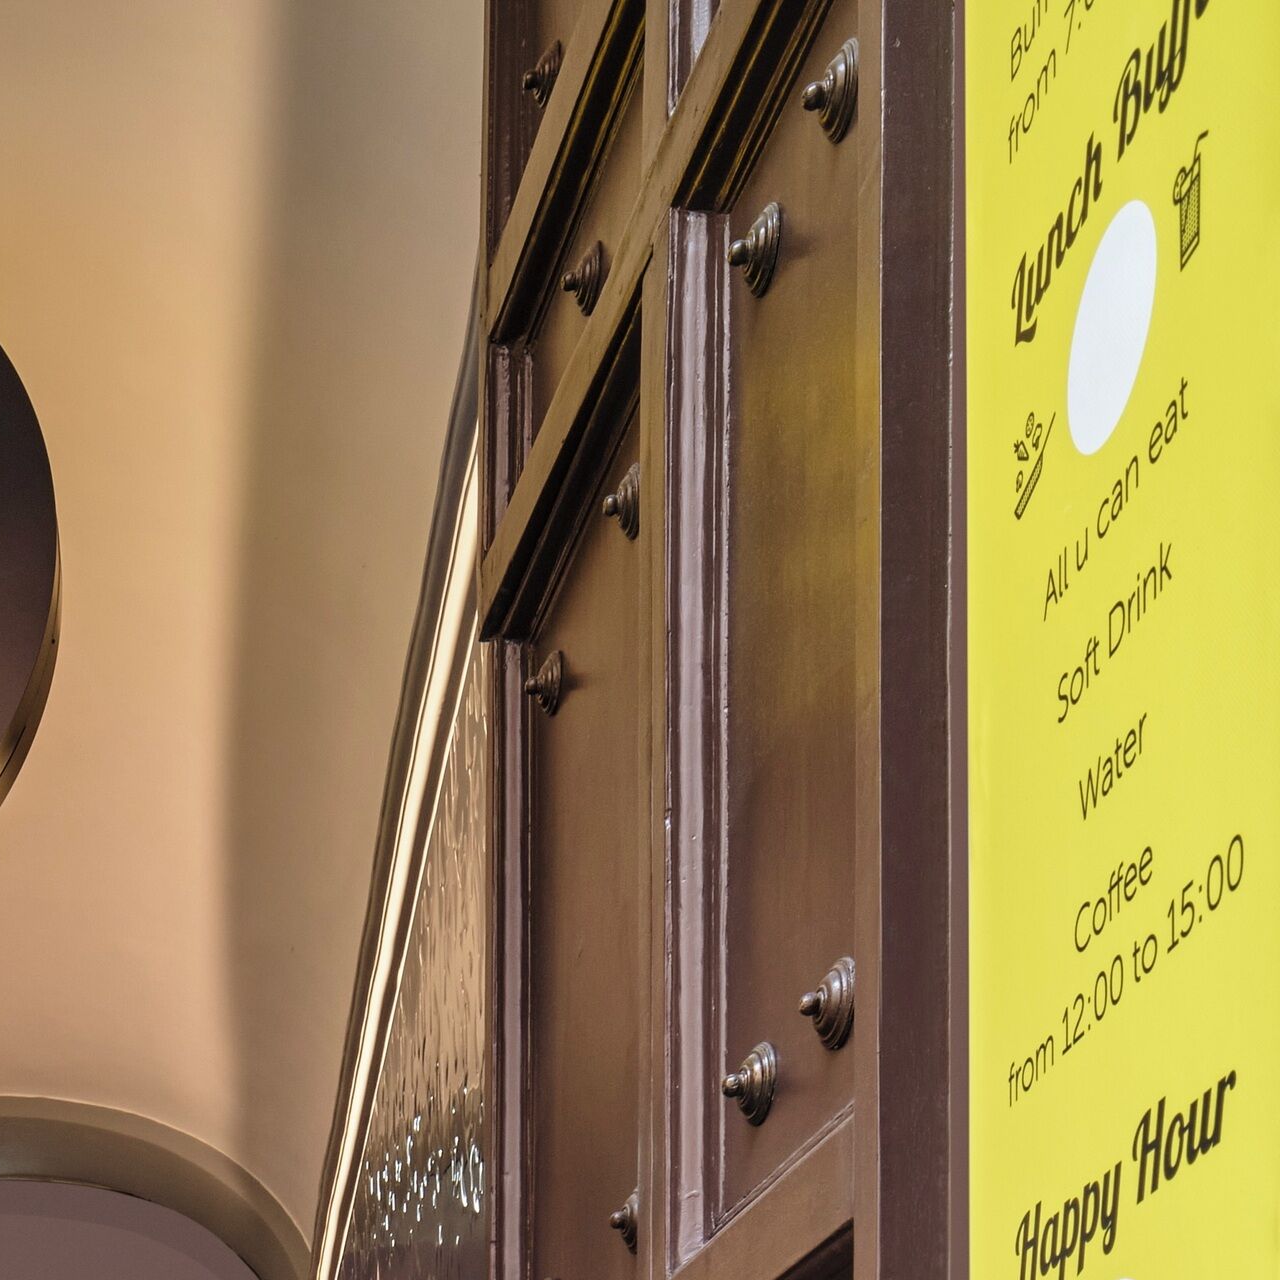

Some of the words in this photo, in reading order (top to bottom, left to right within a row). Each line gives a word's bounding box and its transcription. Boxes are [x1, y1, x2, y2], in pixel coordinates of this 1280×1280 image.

[1009, 49, 1055, 163] from
[1012, 133, 1102, 346] Lunch
[1044, 547, 1068, 621] All
[1077, 528, 1087, 571] u
[1097, 456, 1138, 538] can
[1149, 378, 1188, 464] eat
[1058, 637, 1099, 723] Soft
[1109, 543, 1171, 657] Drink
[1079, 713, 1146, 820] Water
[1009, 1036, 1053, 1106] from
[1063, 955, 1123, 1055] 12:00
[1133, 934, 1157, 982] to
[1168, 835, 1243, 953] 15:00
[1075, 847, 1152, 952] Coffee
[1133, 1071, 1236, 1204] Hour
